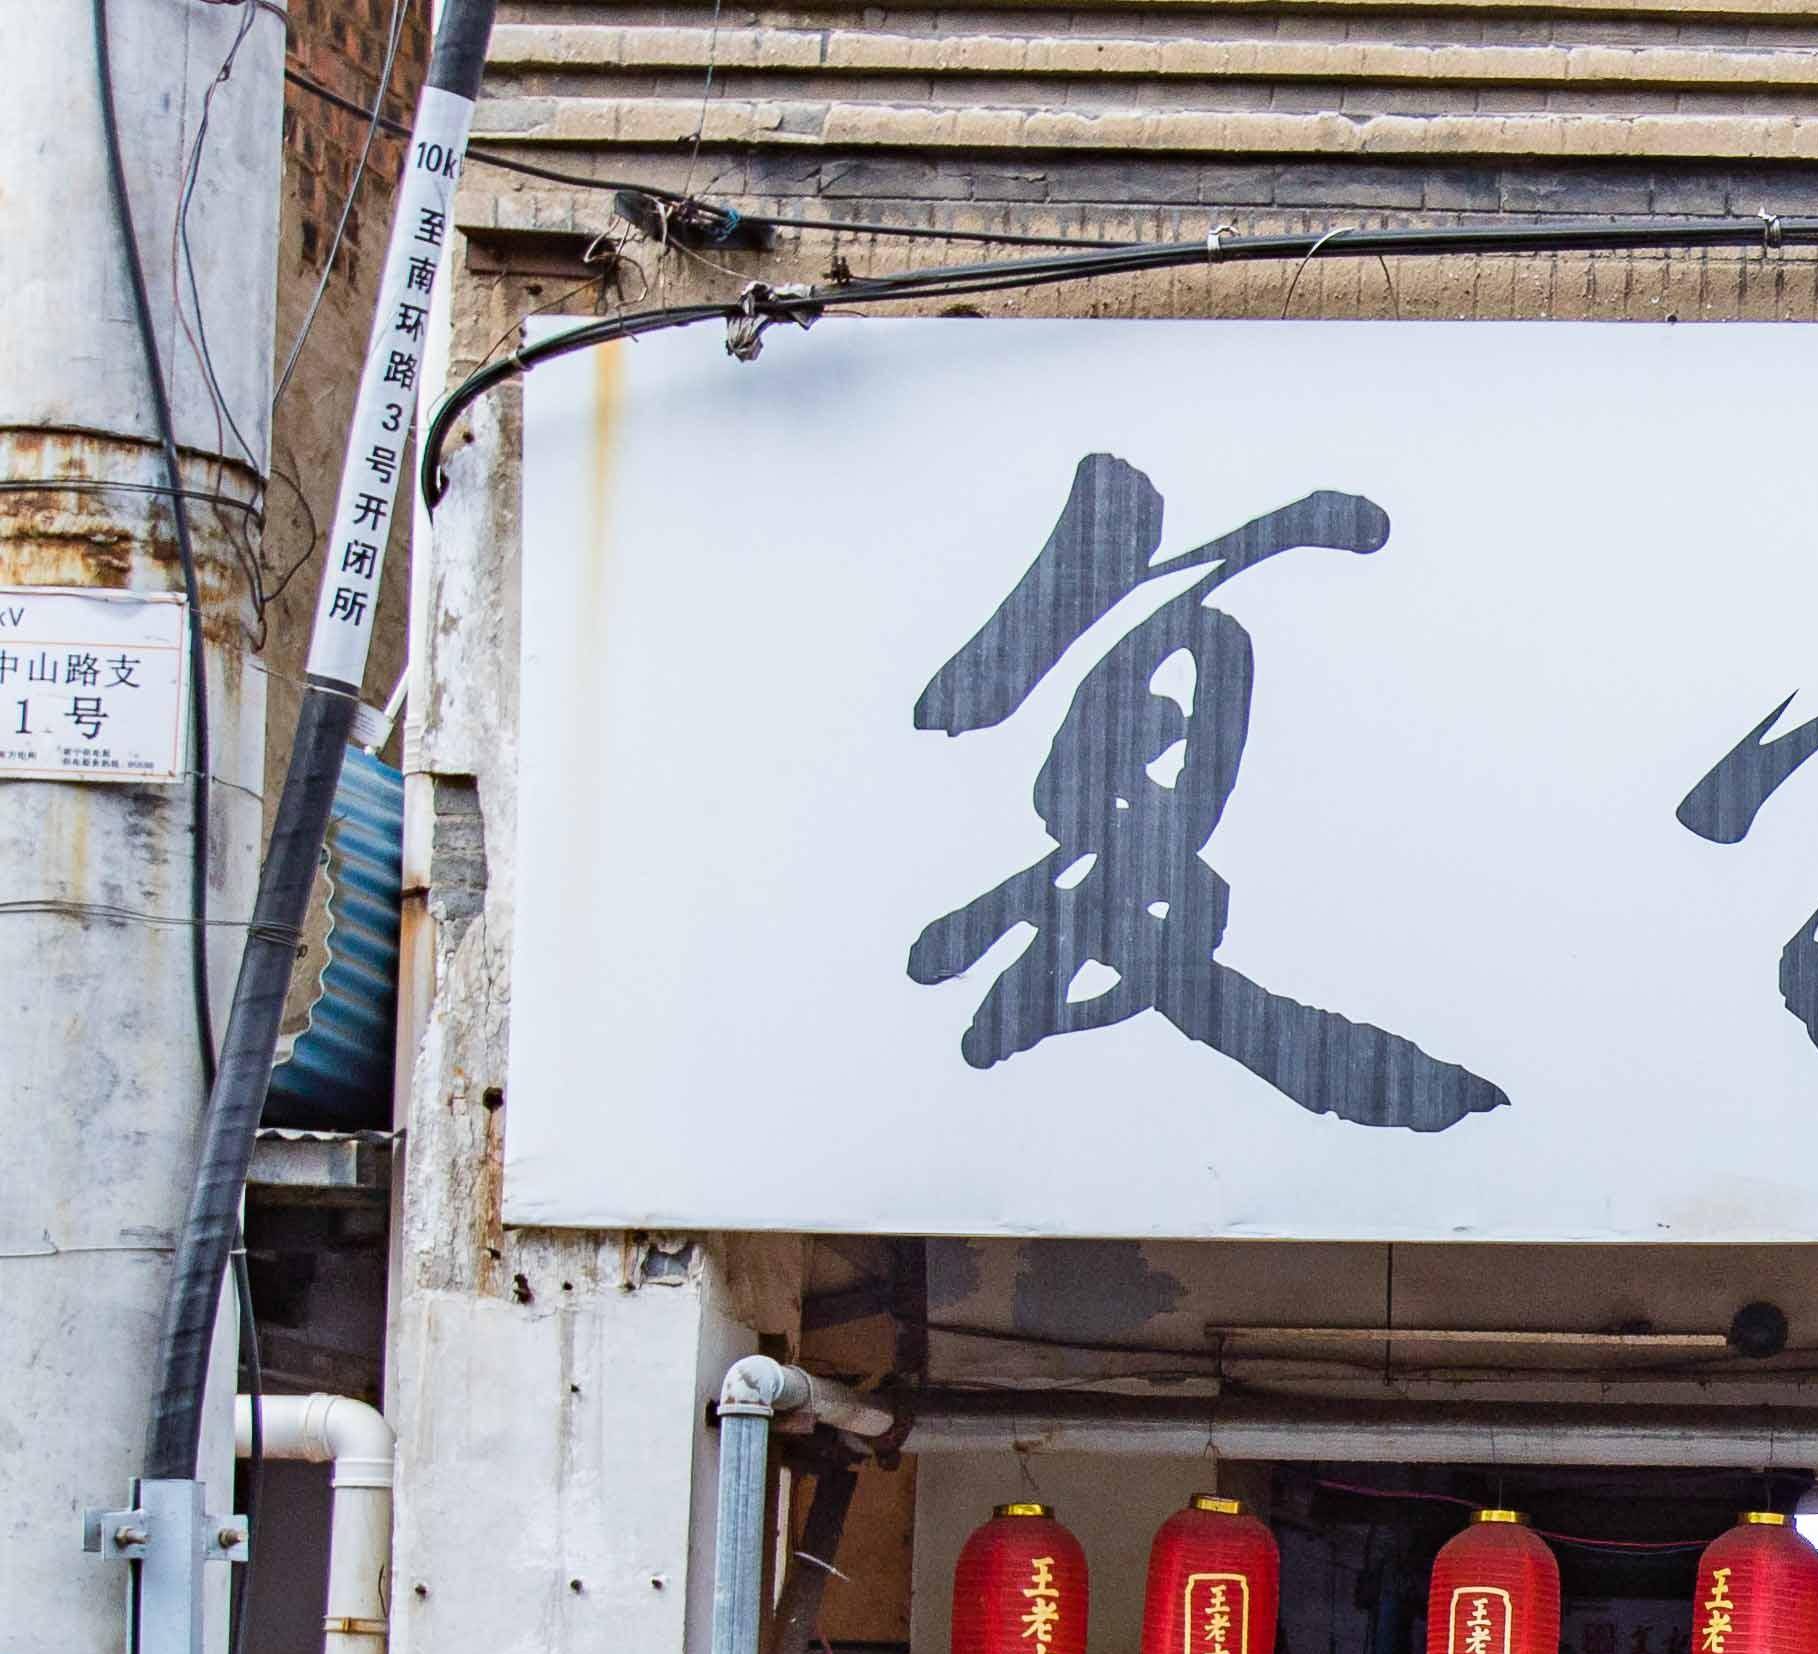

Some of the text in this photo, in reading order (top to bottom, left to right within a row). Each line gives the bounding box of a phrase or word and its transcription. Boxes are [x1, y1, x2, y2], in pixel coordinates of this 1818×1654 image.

[329, 207, 446, 626] 至南环路3号开闭所
